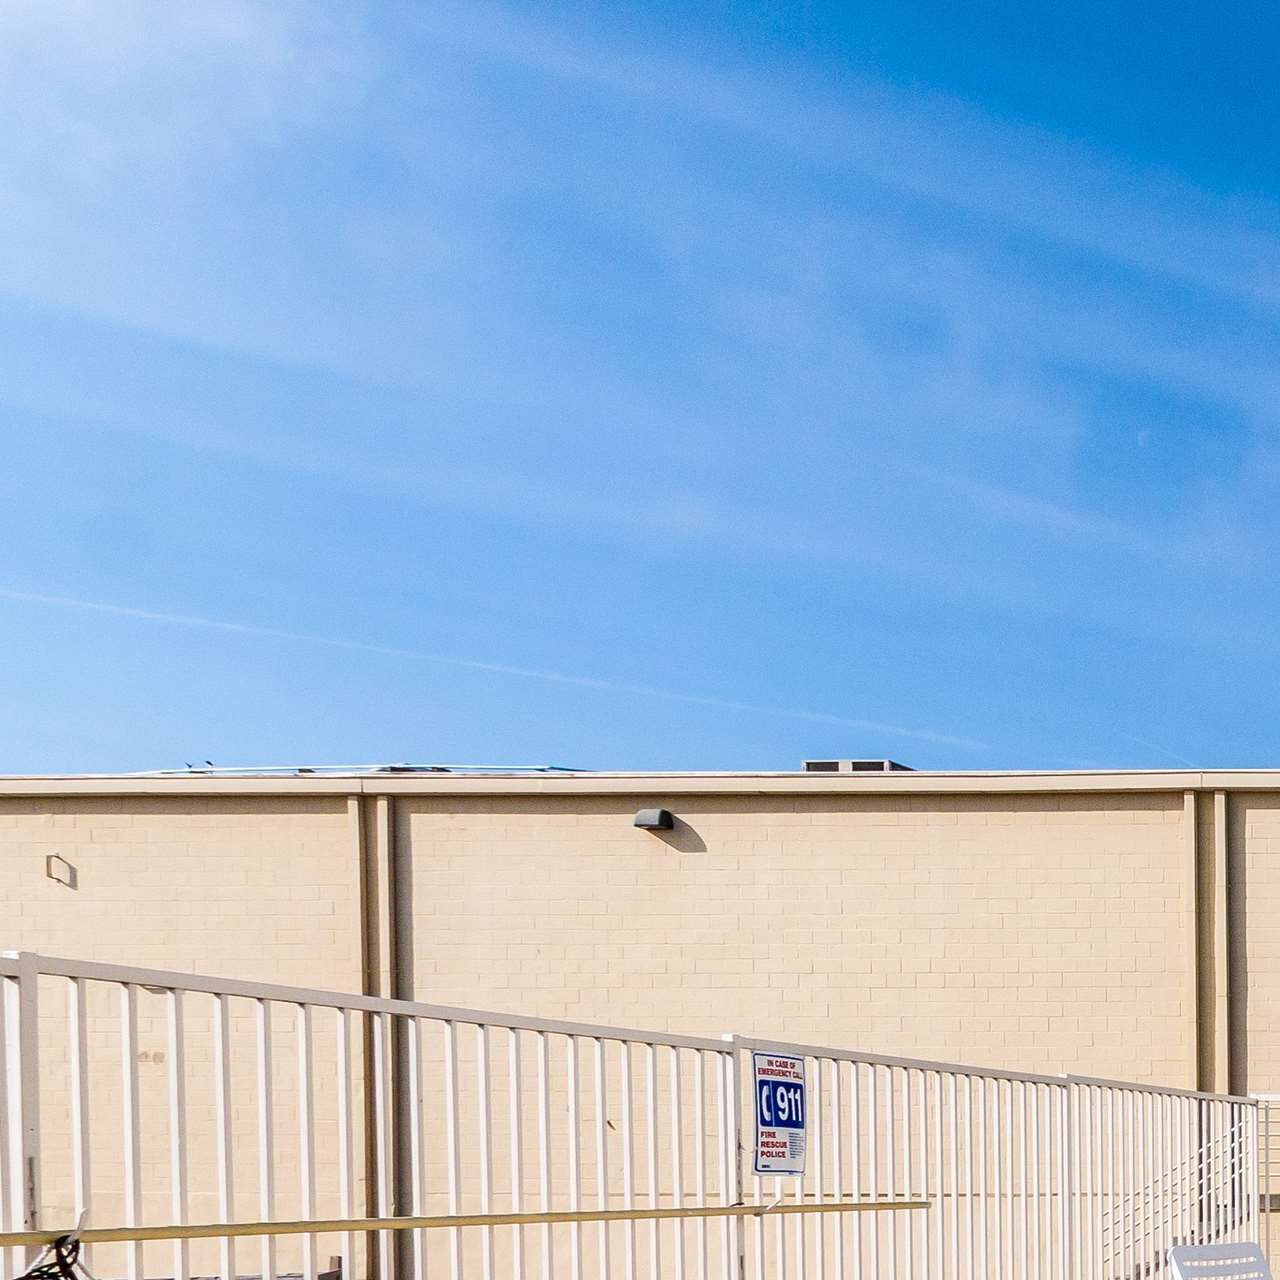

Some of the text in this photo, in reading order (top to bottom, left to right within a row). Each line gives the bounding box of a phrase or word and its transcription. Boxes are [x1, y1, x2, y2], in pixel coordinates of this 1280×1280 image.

[767, 1059, 774, 1067] IN
[775, 1060, 789, 1069] CASE
[757, 1067, 803, 1080] EMERGENCY CALL
[776, 1085, 802, 1122] 911
[760, 1131, 776, 1139] FIRE
[760, 1150, 786, 1158] POLICE
